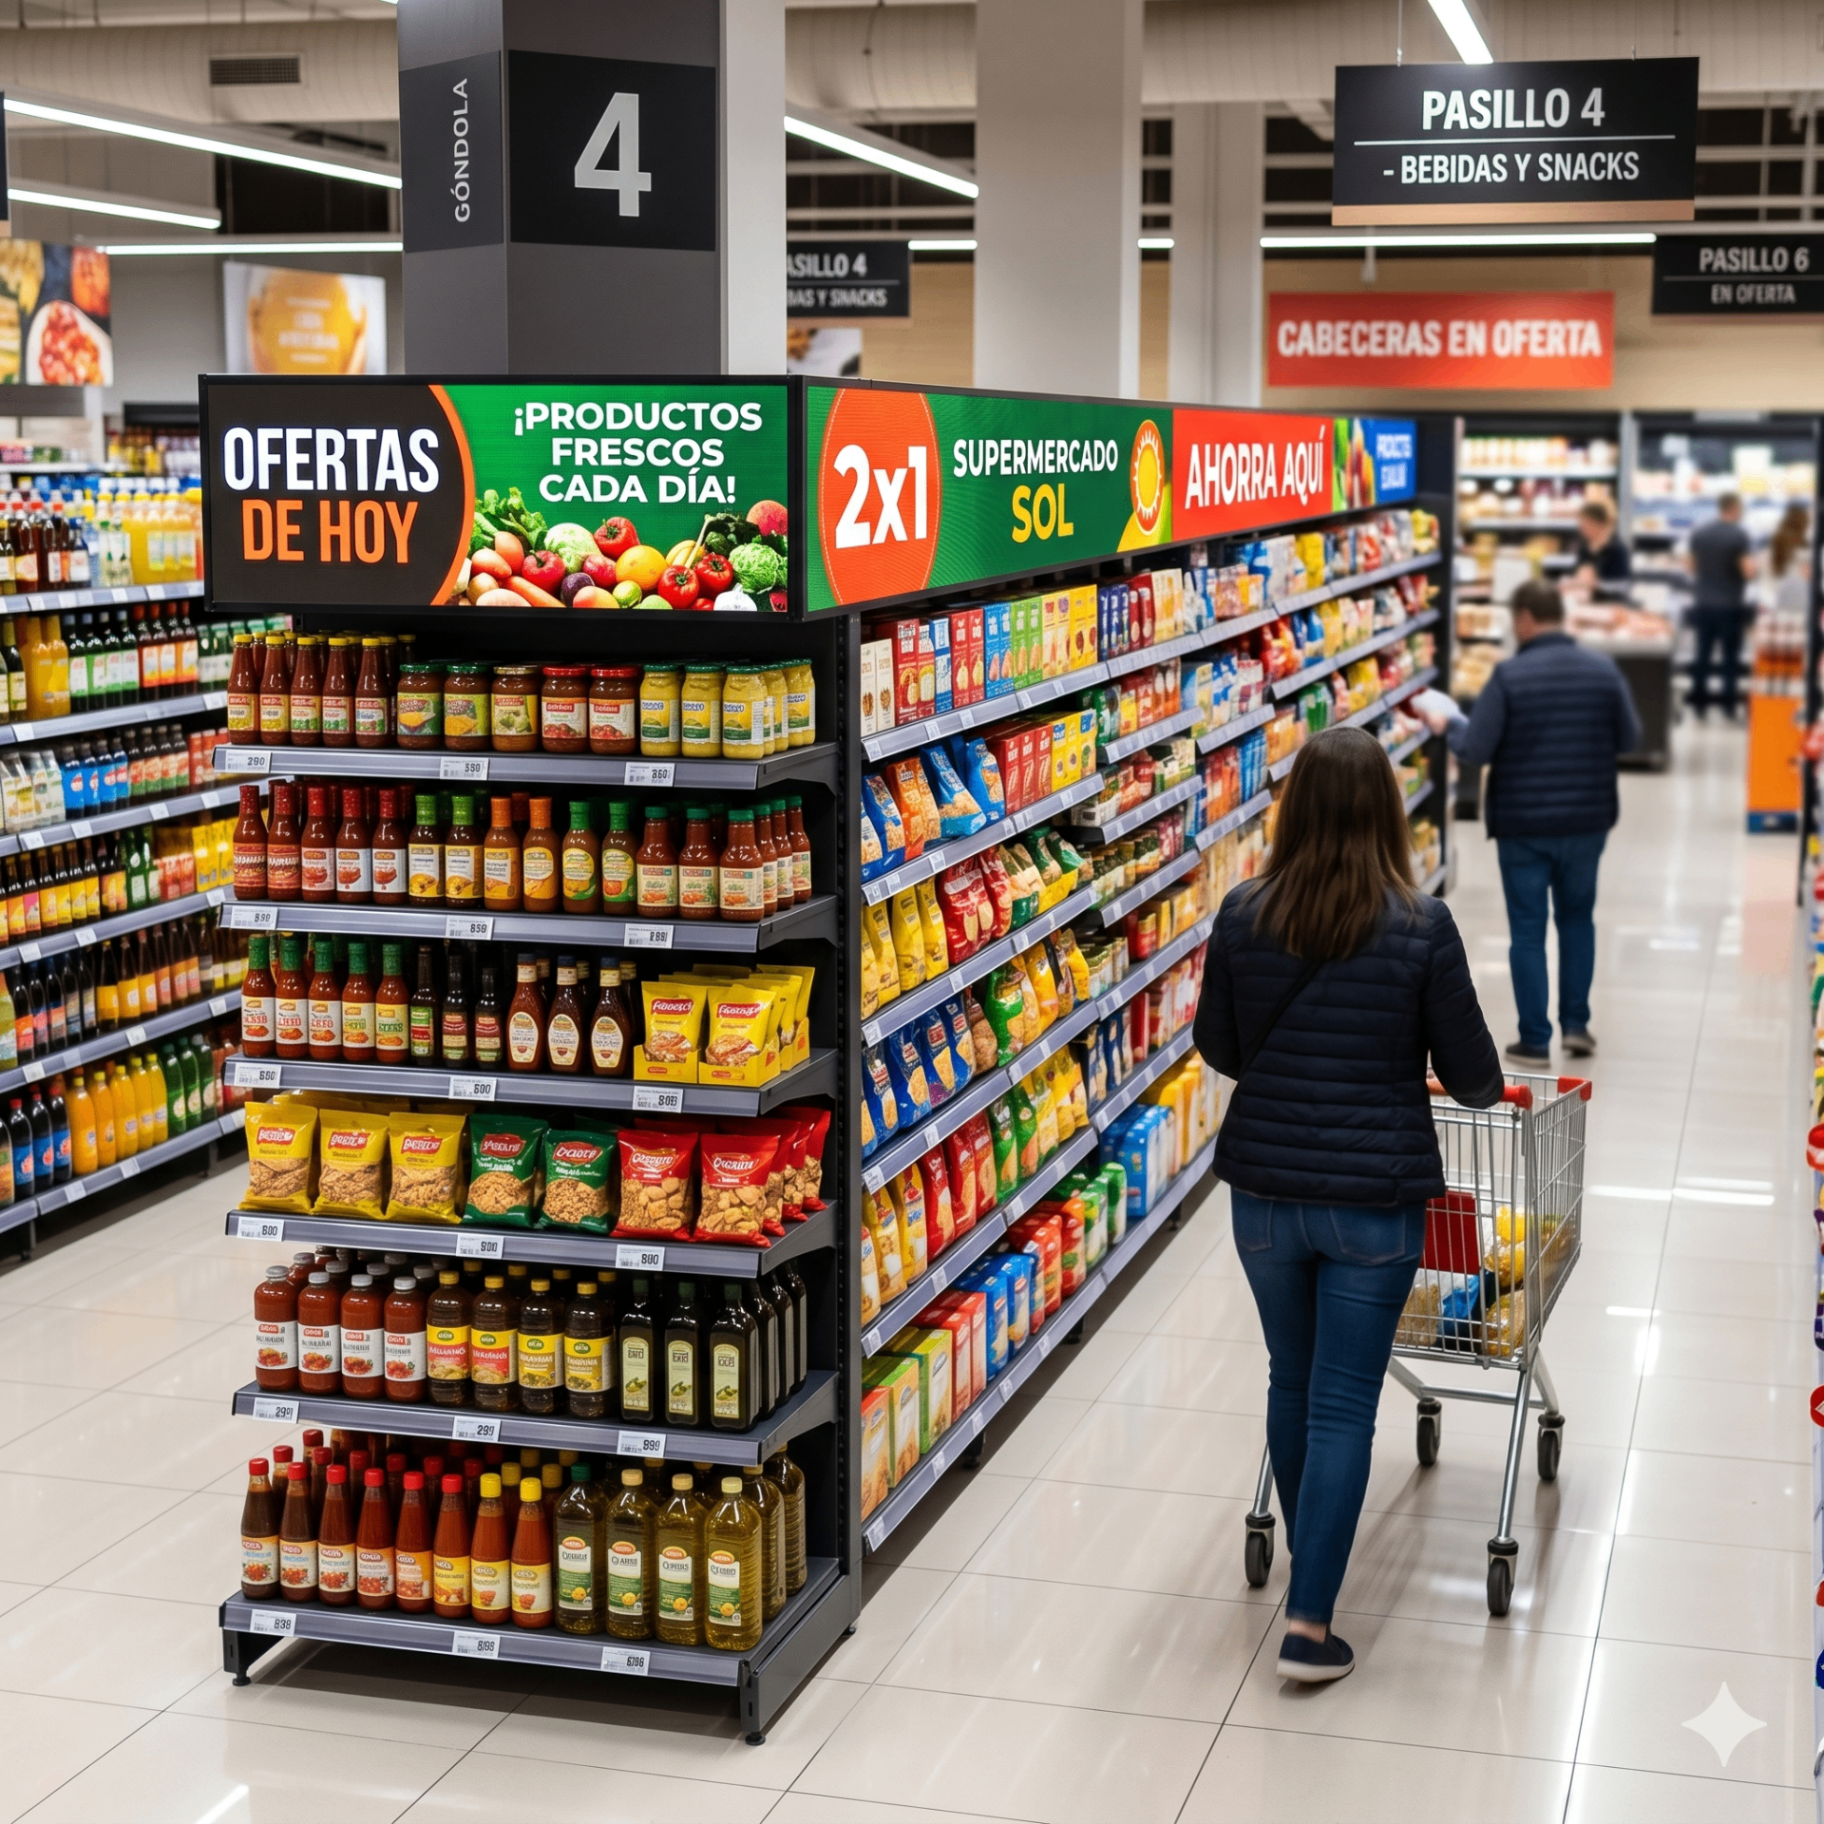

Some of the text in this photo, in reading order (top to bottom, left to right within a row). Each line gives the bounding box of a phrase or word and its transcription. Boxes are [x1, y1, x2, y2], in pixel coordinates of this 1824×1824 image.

[1422, 87, 1606, 130] PASILLO 4
[450, 78, 471, 222] GÓNDOLA
[574, 92, 652, 217] 4
[1401, 153, 1508, 184] BEBIDAS
[1514, 153, 1532, 182] Y
[1538, 151, 1640, 182] SNACKS
[787, 253, 868, 278] ASILLO 4
[1700, 246, 1811, 272] PASILLO 6
[1711, 283, 1797, 304] EN OFERTA
[1278, 319, 1602, 358] CABECERAS EN OFERTA
[514, 402, 763, 436] ¡PRODUCTOS
[223, 427, 440, 493] OFERTAS
[551, 438, 724, 467] FRESCOS
[953, 439, 1118, 477] SUPERMERCADO
[1185, 425, 1326, 509] AHORRA AQUÍ
[538, 466, 736, 504] CADA DÍA!
[833, 444, 928, 550] 2x1
[242, 499, 419, 564] DE HOY
[1012, 483, 1075, 543] SOL
